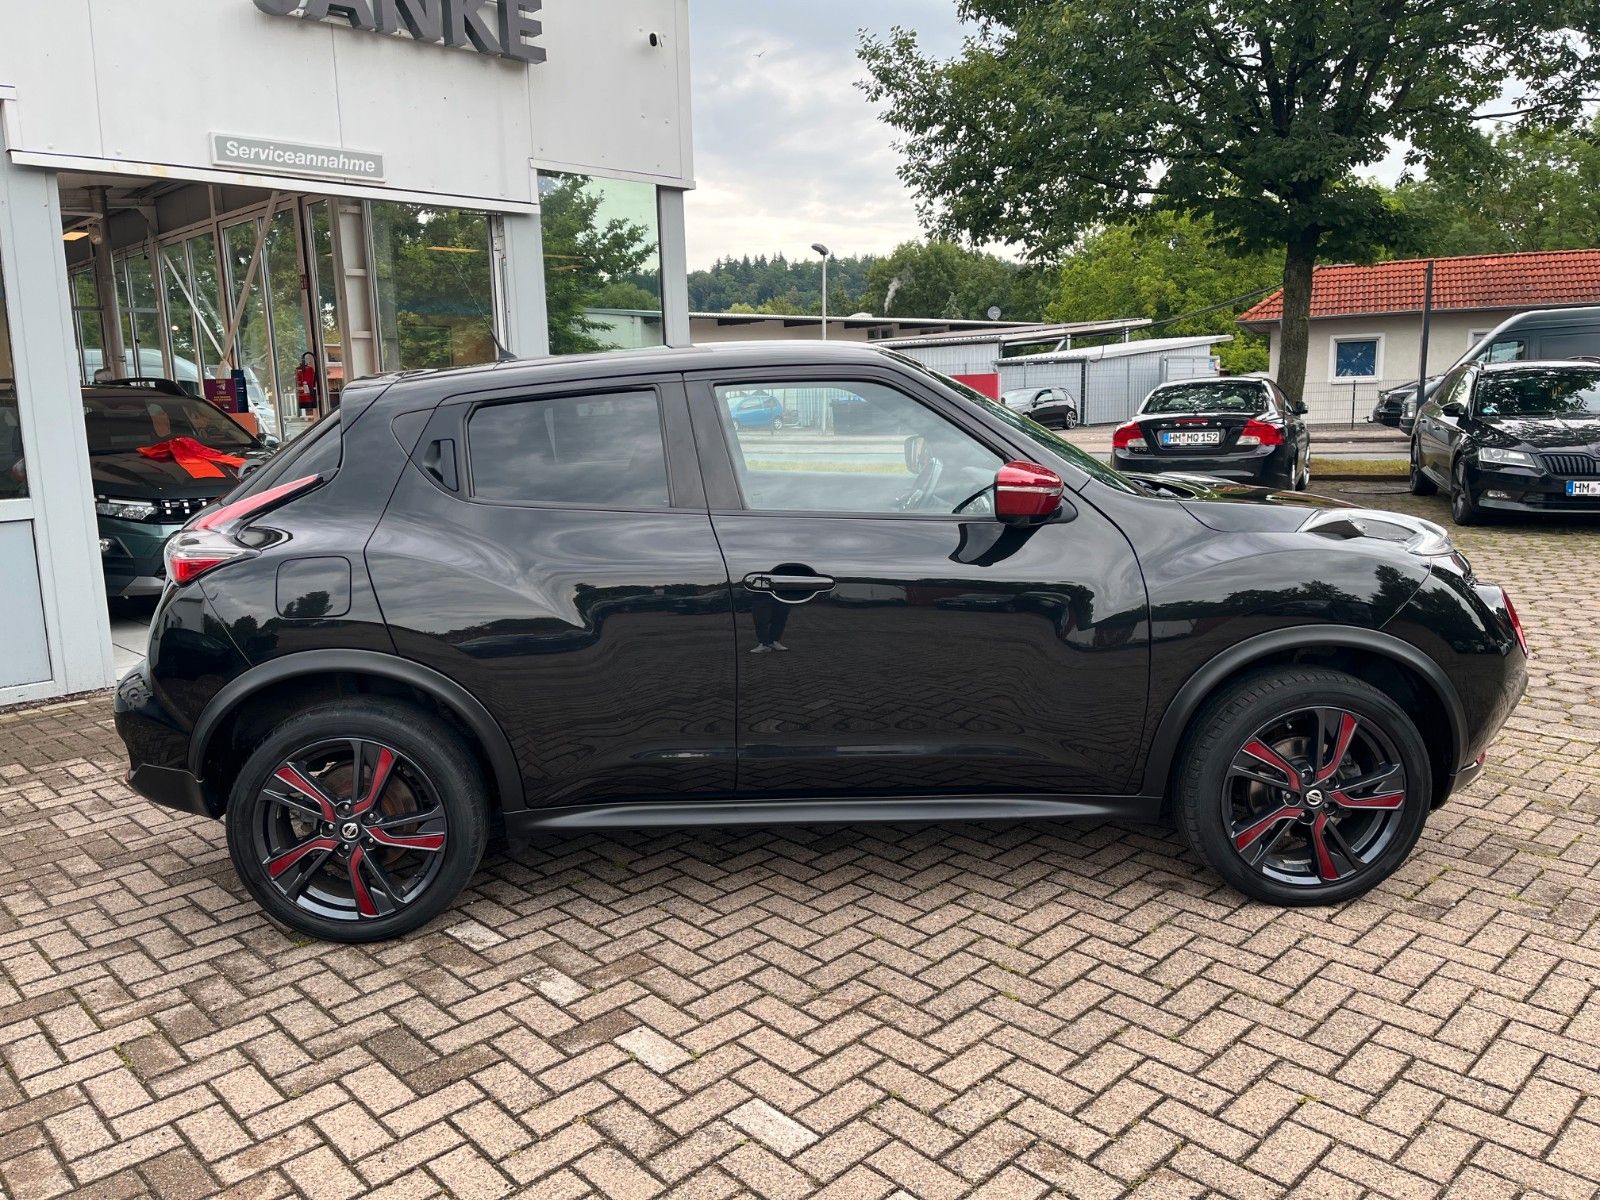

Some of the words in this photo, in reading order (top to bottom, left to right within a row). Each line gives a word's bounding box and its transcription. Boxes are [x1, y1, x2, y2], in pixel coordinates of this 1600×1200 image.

[225, 140, 376, 173] Serviceannahme
[1169, 432, 1181, 443] HM
[1201, 432, 1219, 443] 152
[1574, 482, 1590, 494] HM
